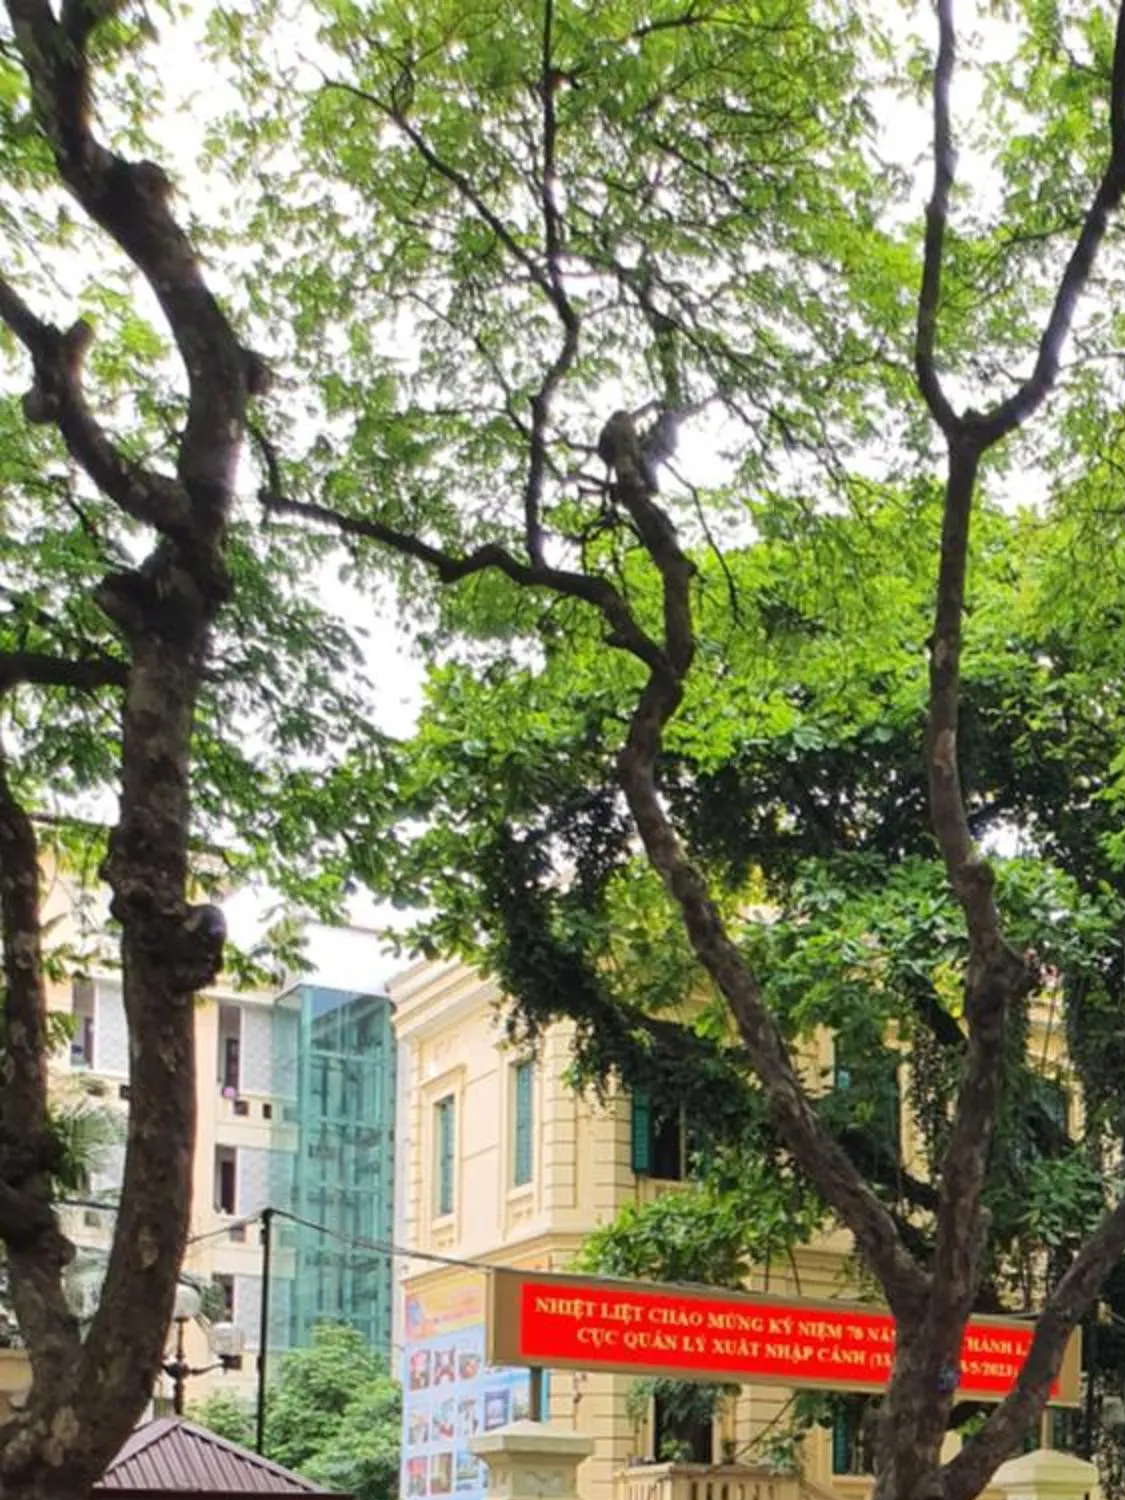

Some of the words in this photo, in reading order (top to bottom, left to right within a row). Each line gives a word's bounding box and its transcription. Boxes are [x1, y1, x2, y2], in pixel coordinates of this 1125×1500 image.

[535, 1297, 596, 1321] NHIỆT
[600, 1302, 644, 1326] LIỆT
[647, 1305, 703, 1327] CHÀO
[797, 1320, 843, 1342] NIỆM
[965, 1335, 1012, 1355] HÀNH
[576, 1326, 619, 1349] CỤC
[623, 1330, 677, 1351] QUẢN
[683, 1333, 706, 1354] LÝ
[711, 1337, 759, 1358] XUẤT
[764, 1341, 813, 1365] NHẬP
[816, 1344, 866, 1366] CẢNH
